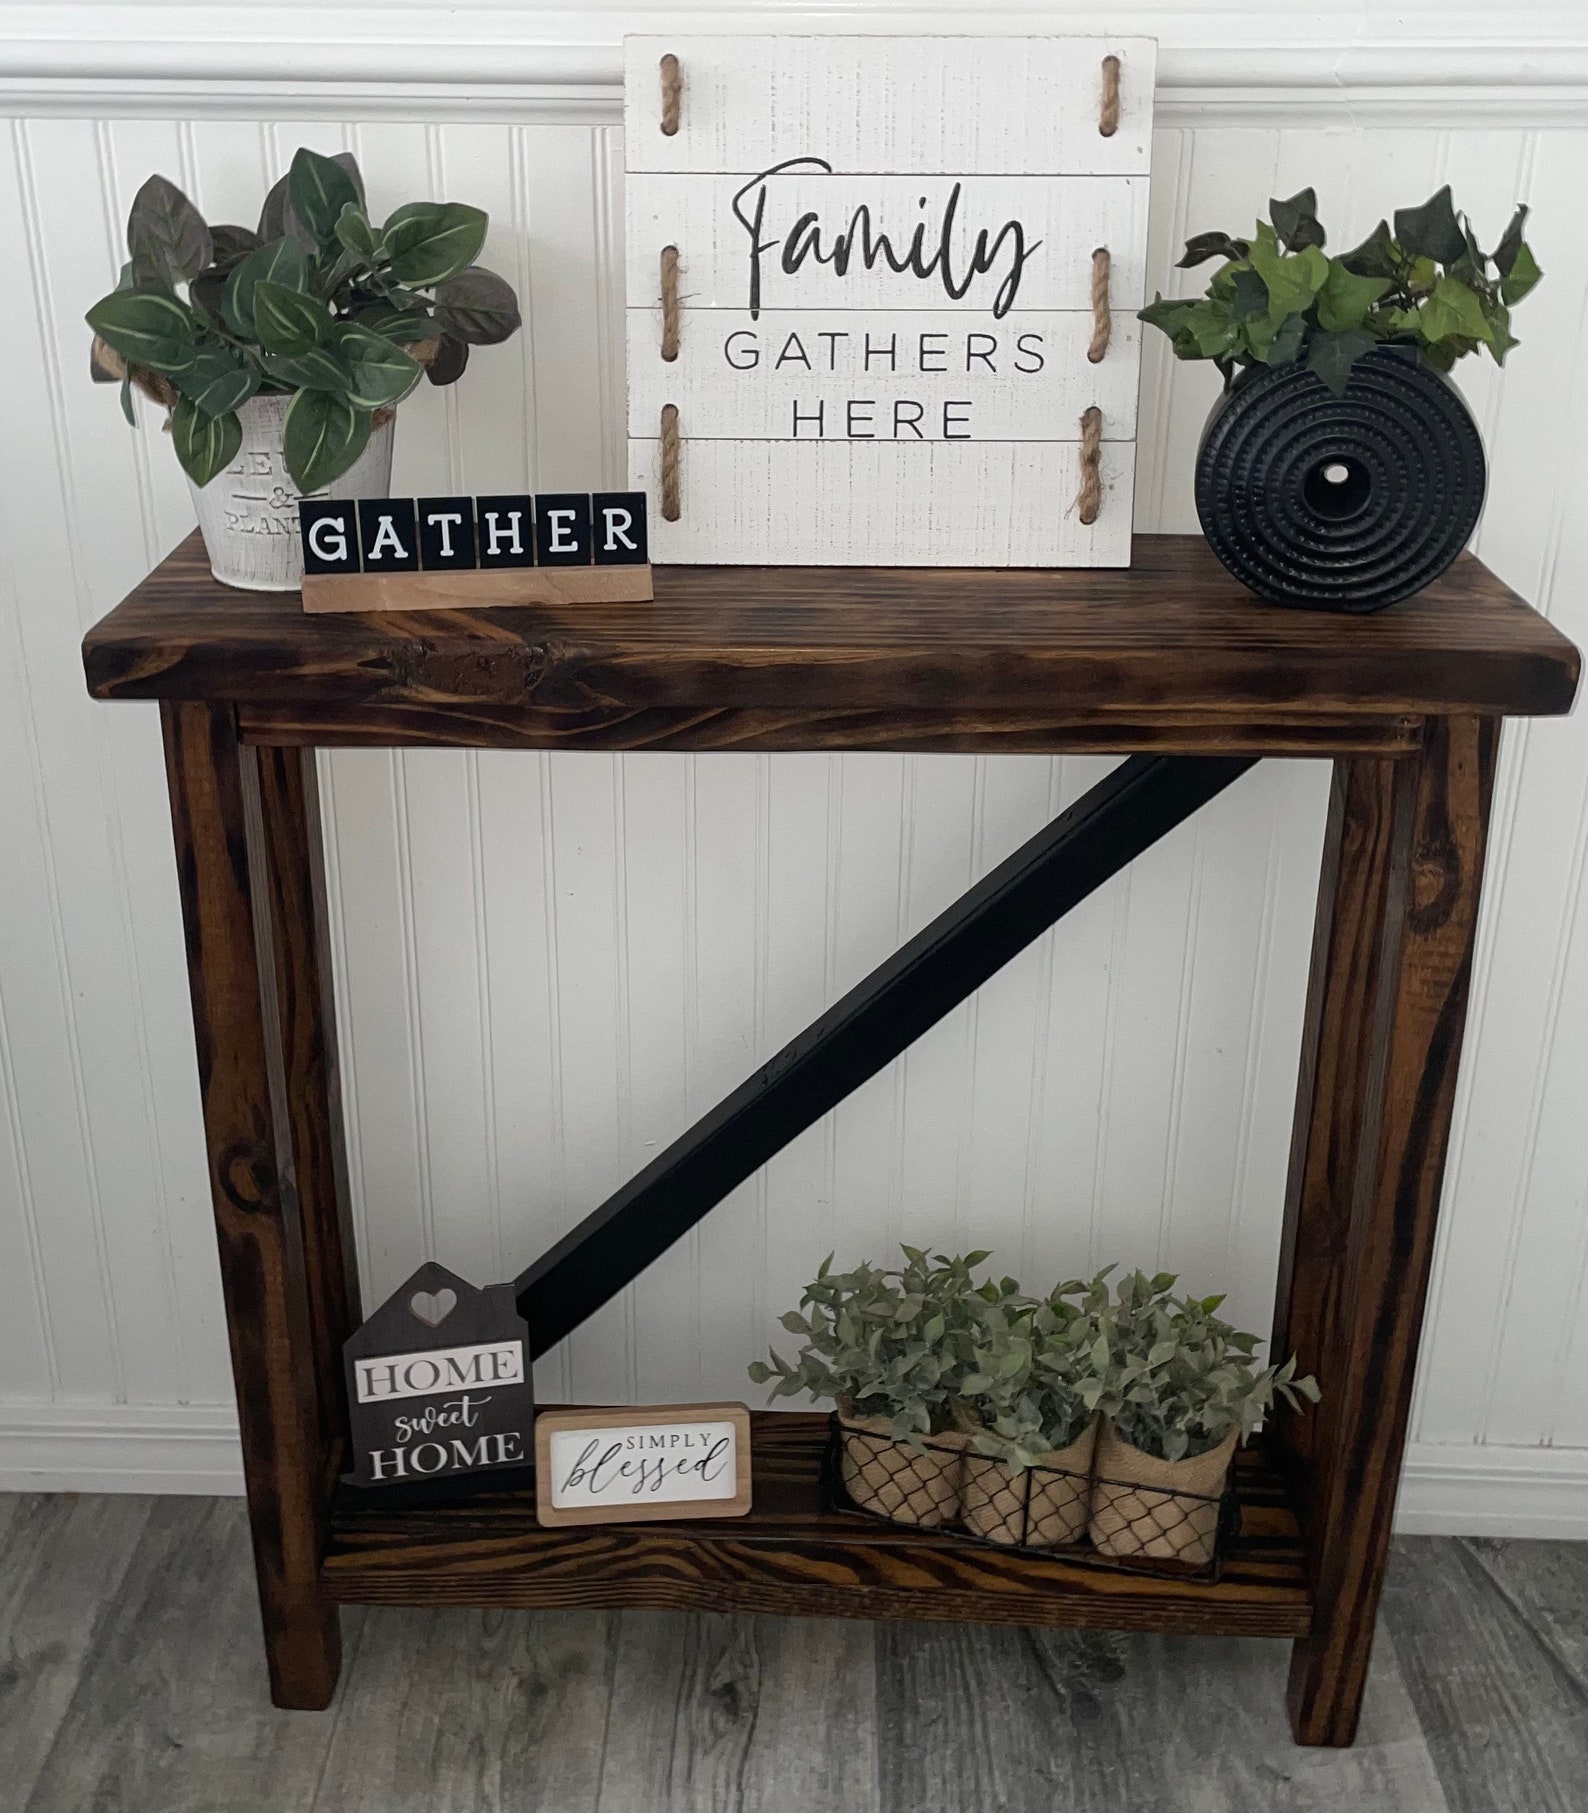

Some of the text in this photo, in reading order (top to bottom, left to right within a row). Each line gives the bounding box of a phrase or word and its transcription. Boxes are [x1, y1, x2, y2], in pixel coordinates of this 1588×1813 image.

[732, 157, 1043, 321] Family
[724, 331, 1045, 373] GATHERS
[792, 399, 973, 439] HERE
[308, 508, 638, 561] GATHER
[361, 1350, 518, 1397] HOME
[394, 1395, 492, 1443] sweet
[627, 1432, 711, 1450] SIMPLY
[369, 1432, 524, 1480] HOME
[561, 1437, 730, 1494] blessed
